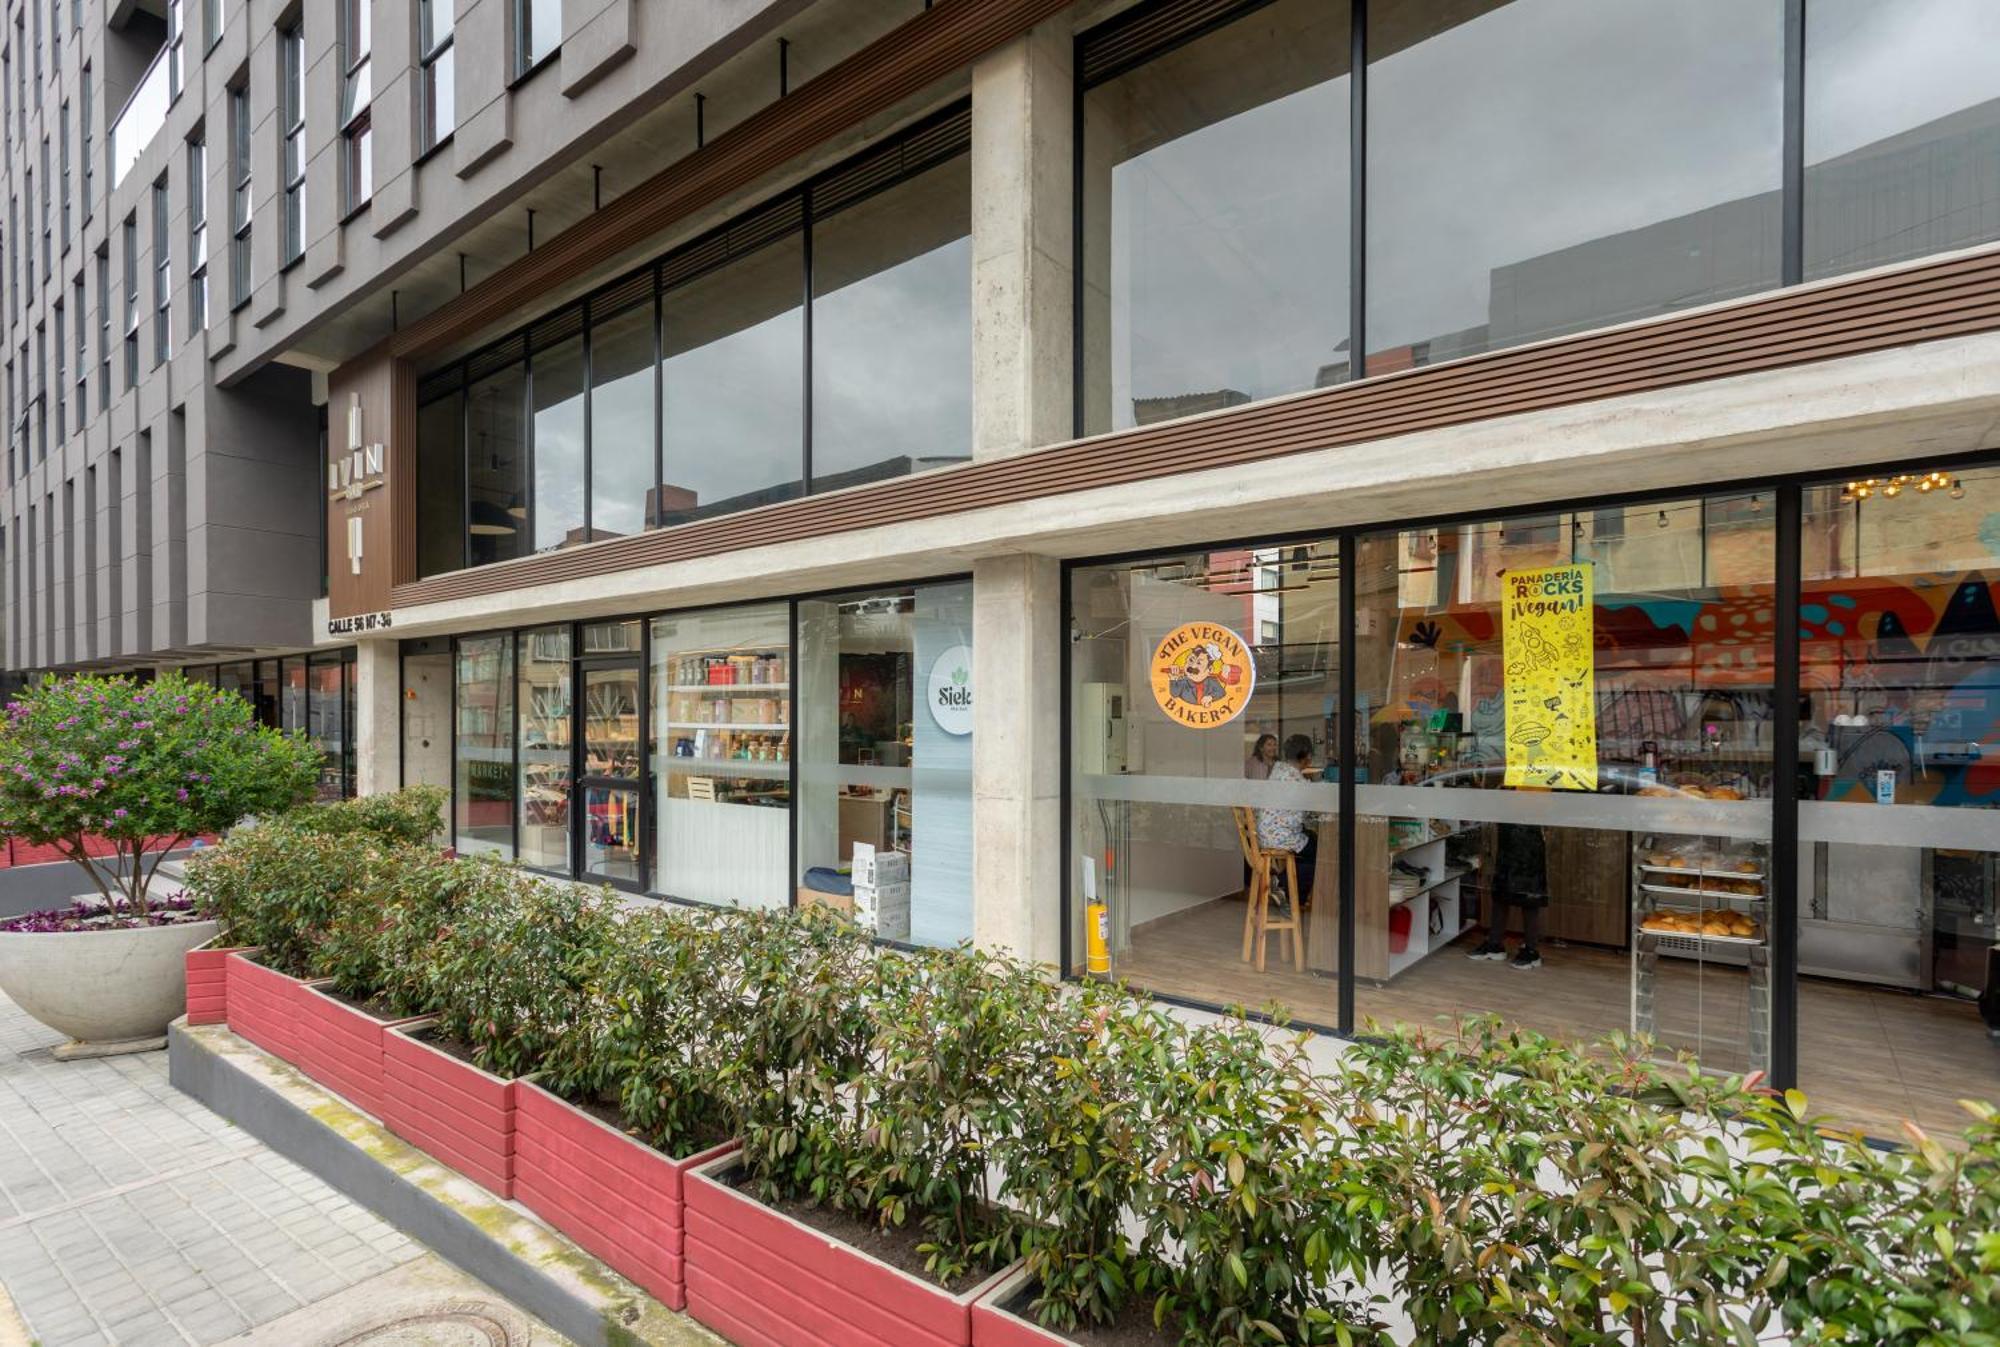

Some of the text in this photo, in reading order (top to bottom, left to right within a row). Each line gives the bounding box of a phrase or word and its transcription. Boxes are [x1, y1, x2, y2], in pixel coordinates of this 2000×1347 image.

[1511, 569, 1584, 586] PANADERÍA
[1516, 580, 1584, 599] ROCKS
[328, 617, 353, 634] CALLE
[354, 615, 364, 631] 56
[1160, 627, 1242, 660] THE VEGAN
[1164, 697, 1234, 723] BAKERY
